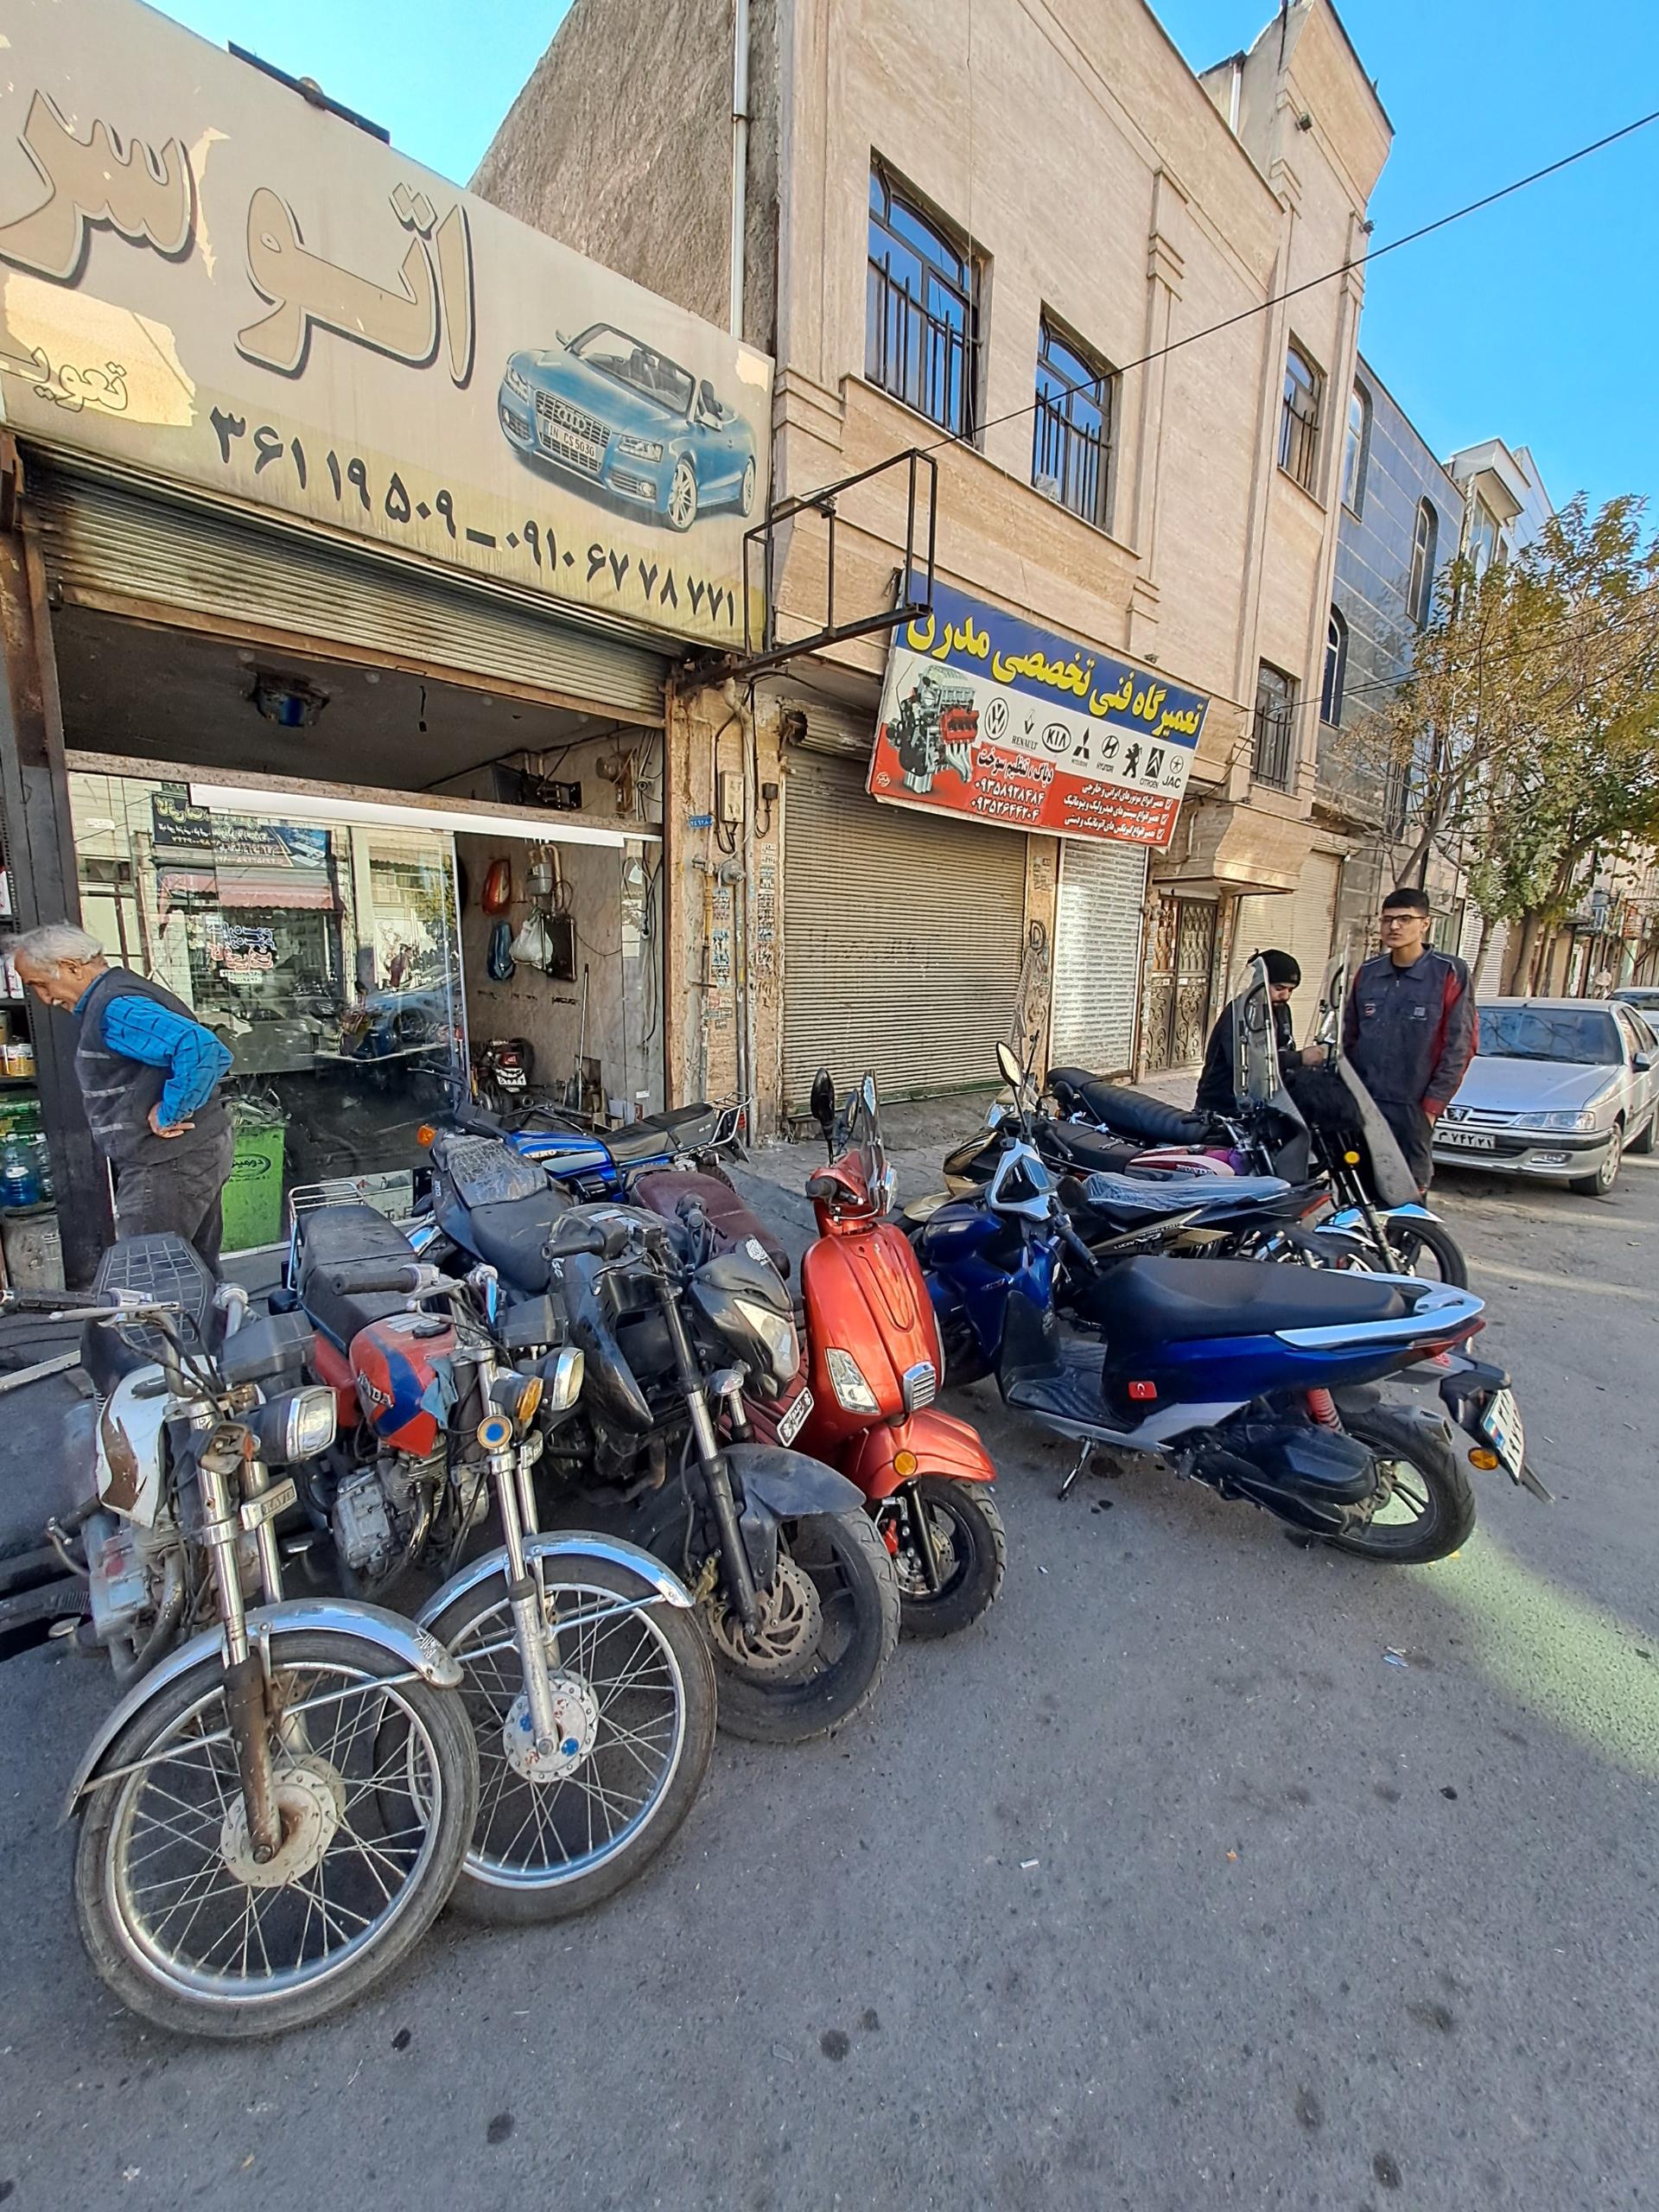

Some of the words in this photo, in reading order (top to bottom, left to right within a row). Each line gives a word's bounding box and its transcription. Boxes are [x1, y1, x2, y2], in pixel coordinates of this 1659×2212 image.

[236, 182, 474, 390] اتو
[906, 614, 991, 660] مدرن
[993, 652, 1096, 697] تخصصی
[1089, 671, 1135, 717] فنی
[1012, 735, 1038, 750] RENAULT
[1046, 728, 1066, 748] KIA
[977, 747, 1007, 776] سوخت
[975, 776, 1046, 806] ۰۹۳۵۸۹۲۸۴۸۴
[1104, 786, 1122, 800] ایرانی
[1162, 774, 1182, 789] JAC
[970, 795, 1040, 822] ۰۹۳۵۲۶۴۴۲۰۴
[1141, 794, 1154, 808] انواع
[1151, 798, 1166, 809] تعمیر
[1452, 1133, 1475, 1146] ۷۴۲
